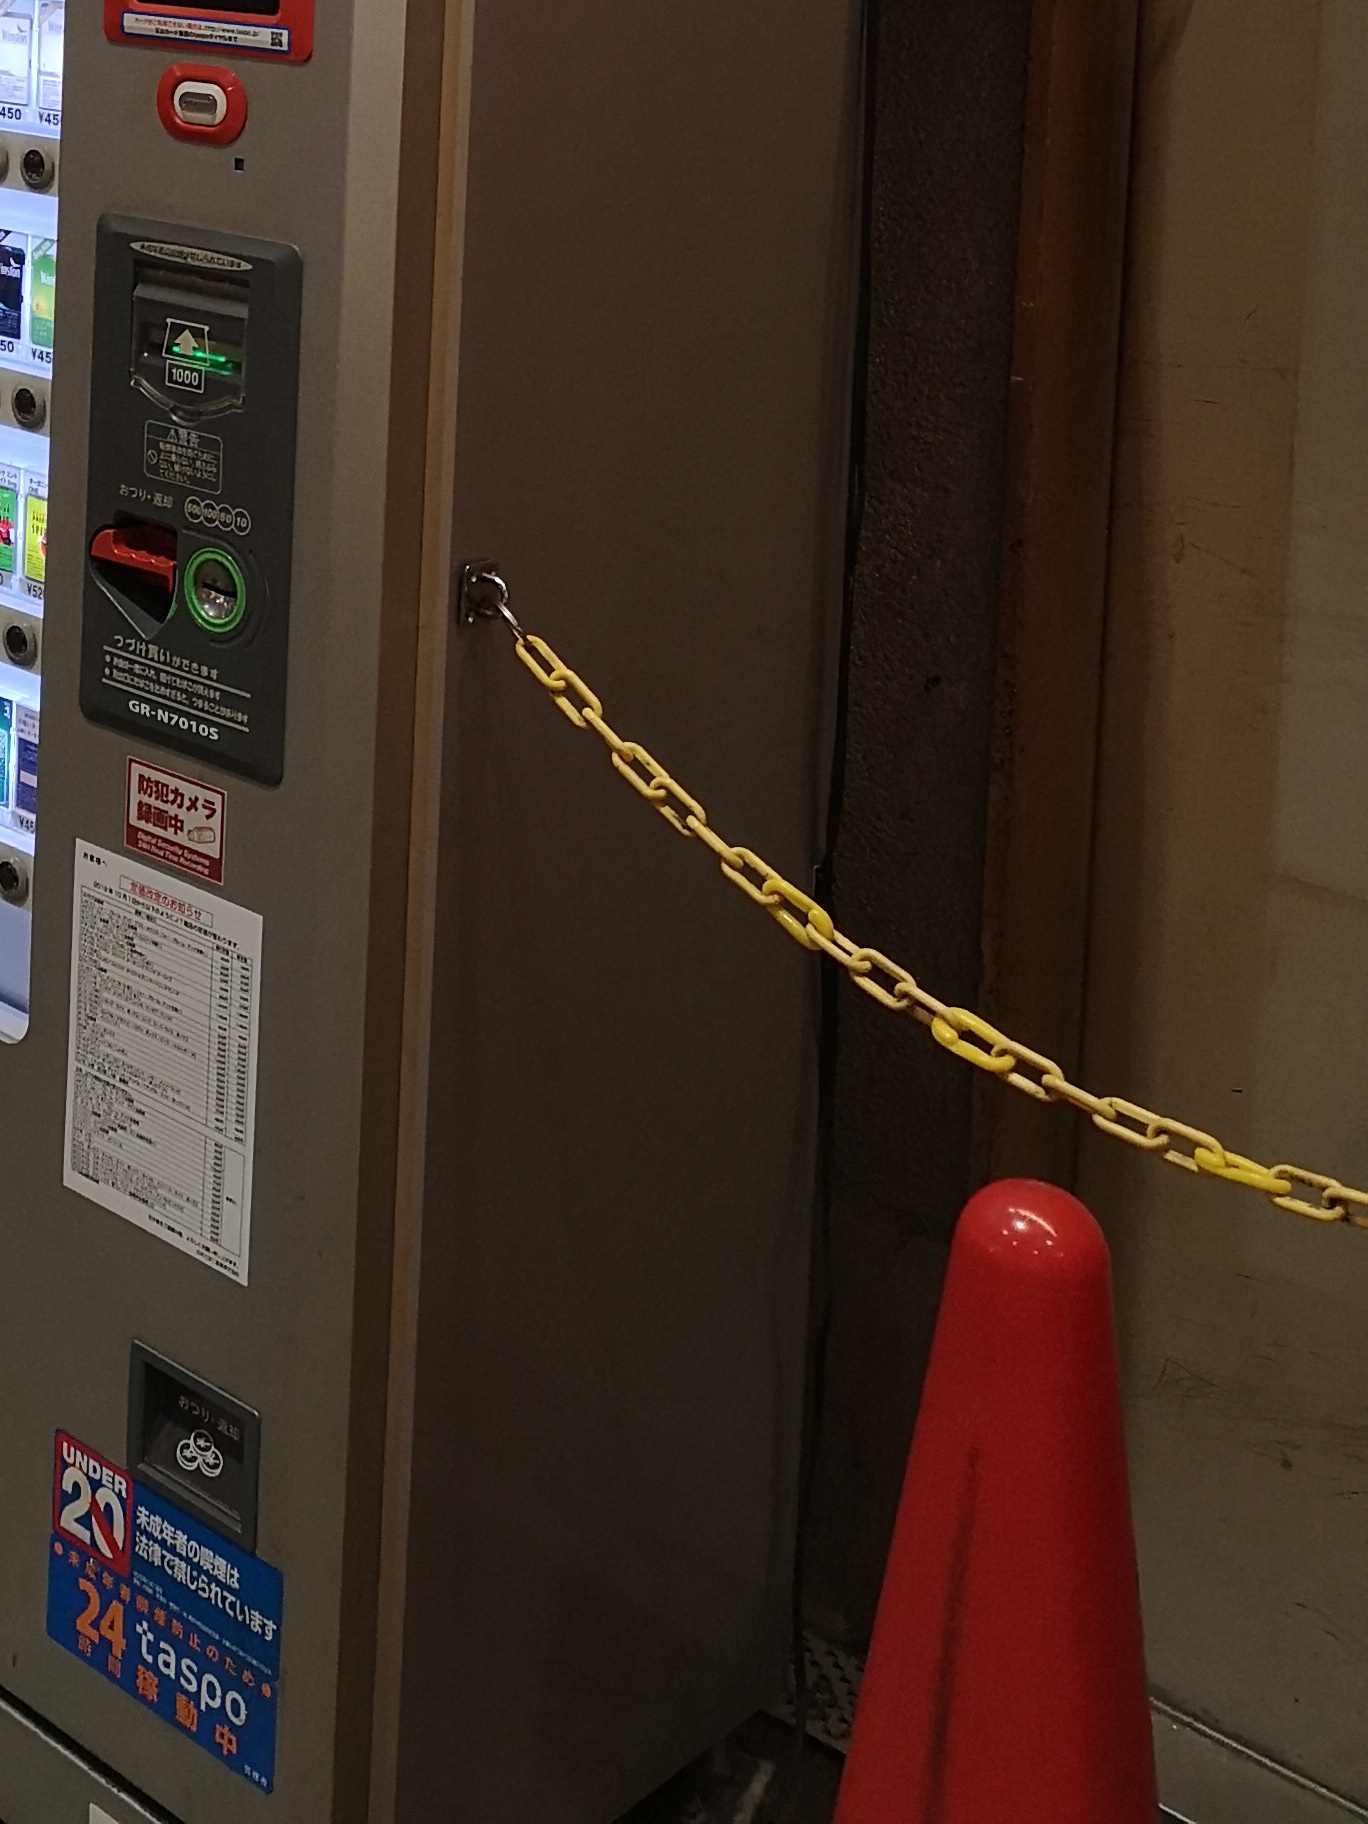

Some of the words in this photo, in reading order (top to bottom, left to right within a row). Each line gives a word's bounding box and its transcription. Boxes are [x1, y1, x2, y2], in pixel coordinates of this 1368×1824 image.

[171, 366, 200, 387] 1000
[128, 699, 220, 741] GR-N7010S
[136, 773, 218, 821] 防犯カメラ
[136, 800, 185, 836] 録画中
[62, 1441, 128, 1499] UNDER
[135, 1504, 240, 1589] 未成年者の喫煙は
[135, 1533, 277, 1642] 法律で禁じられています
[75, 1577, 127, 1660] 24
[135, 1620, 248, 1727] taspo
